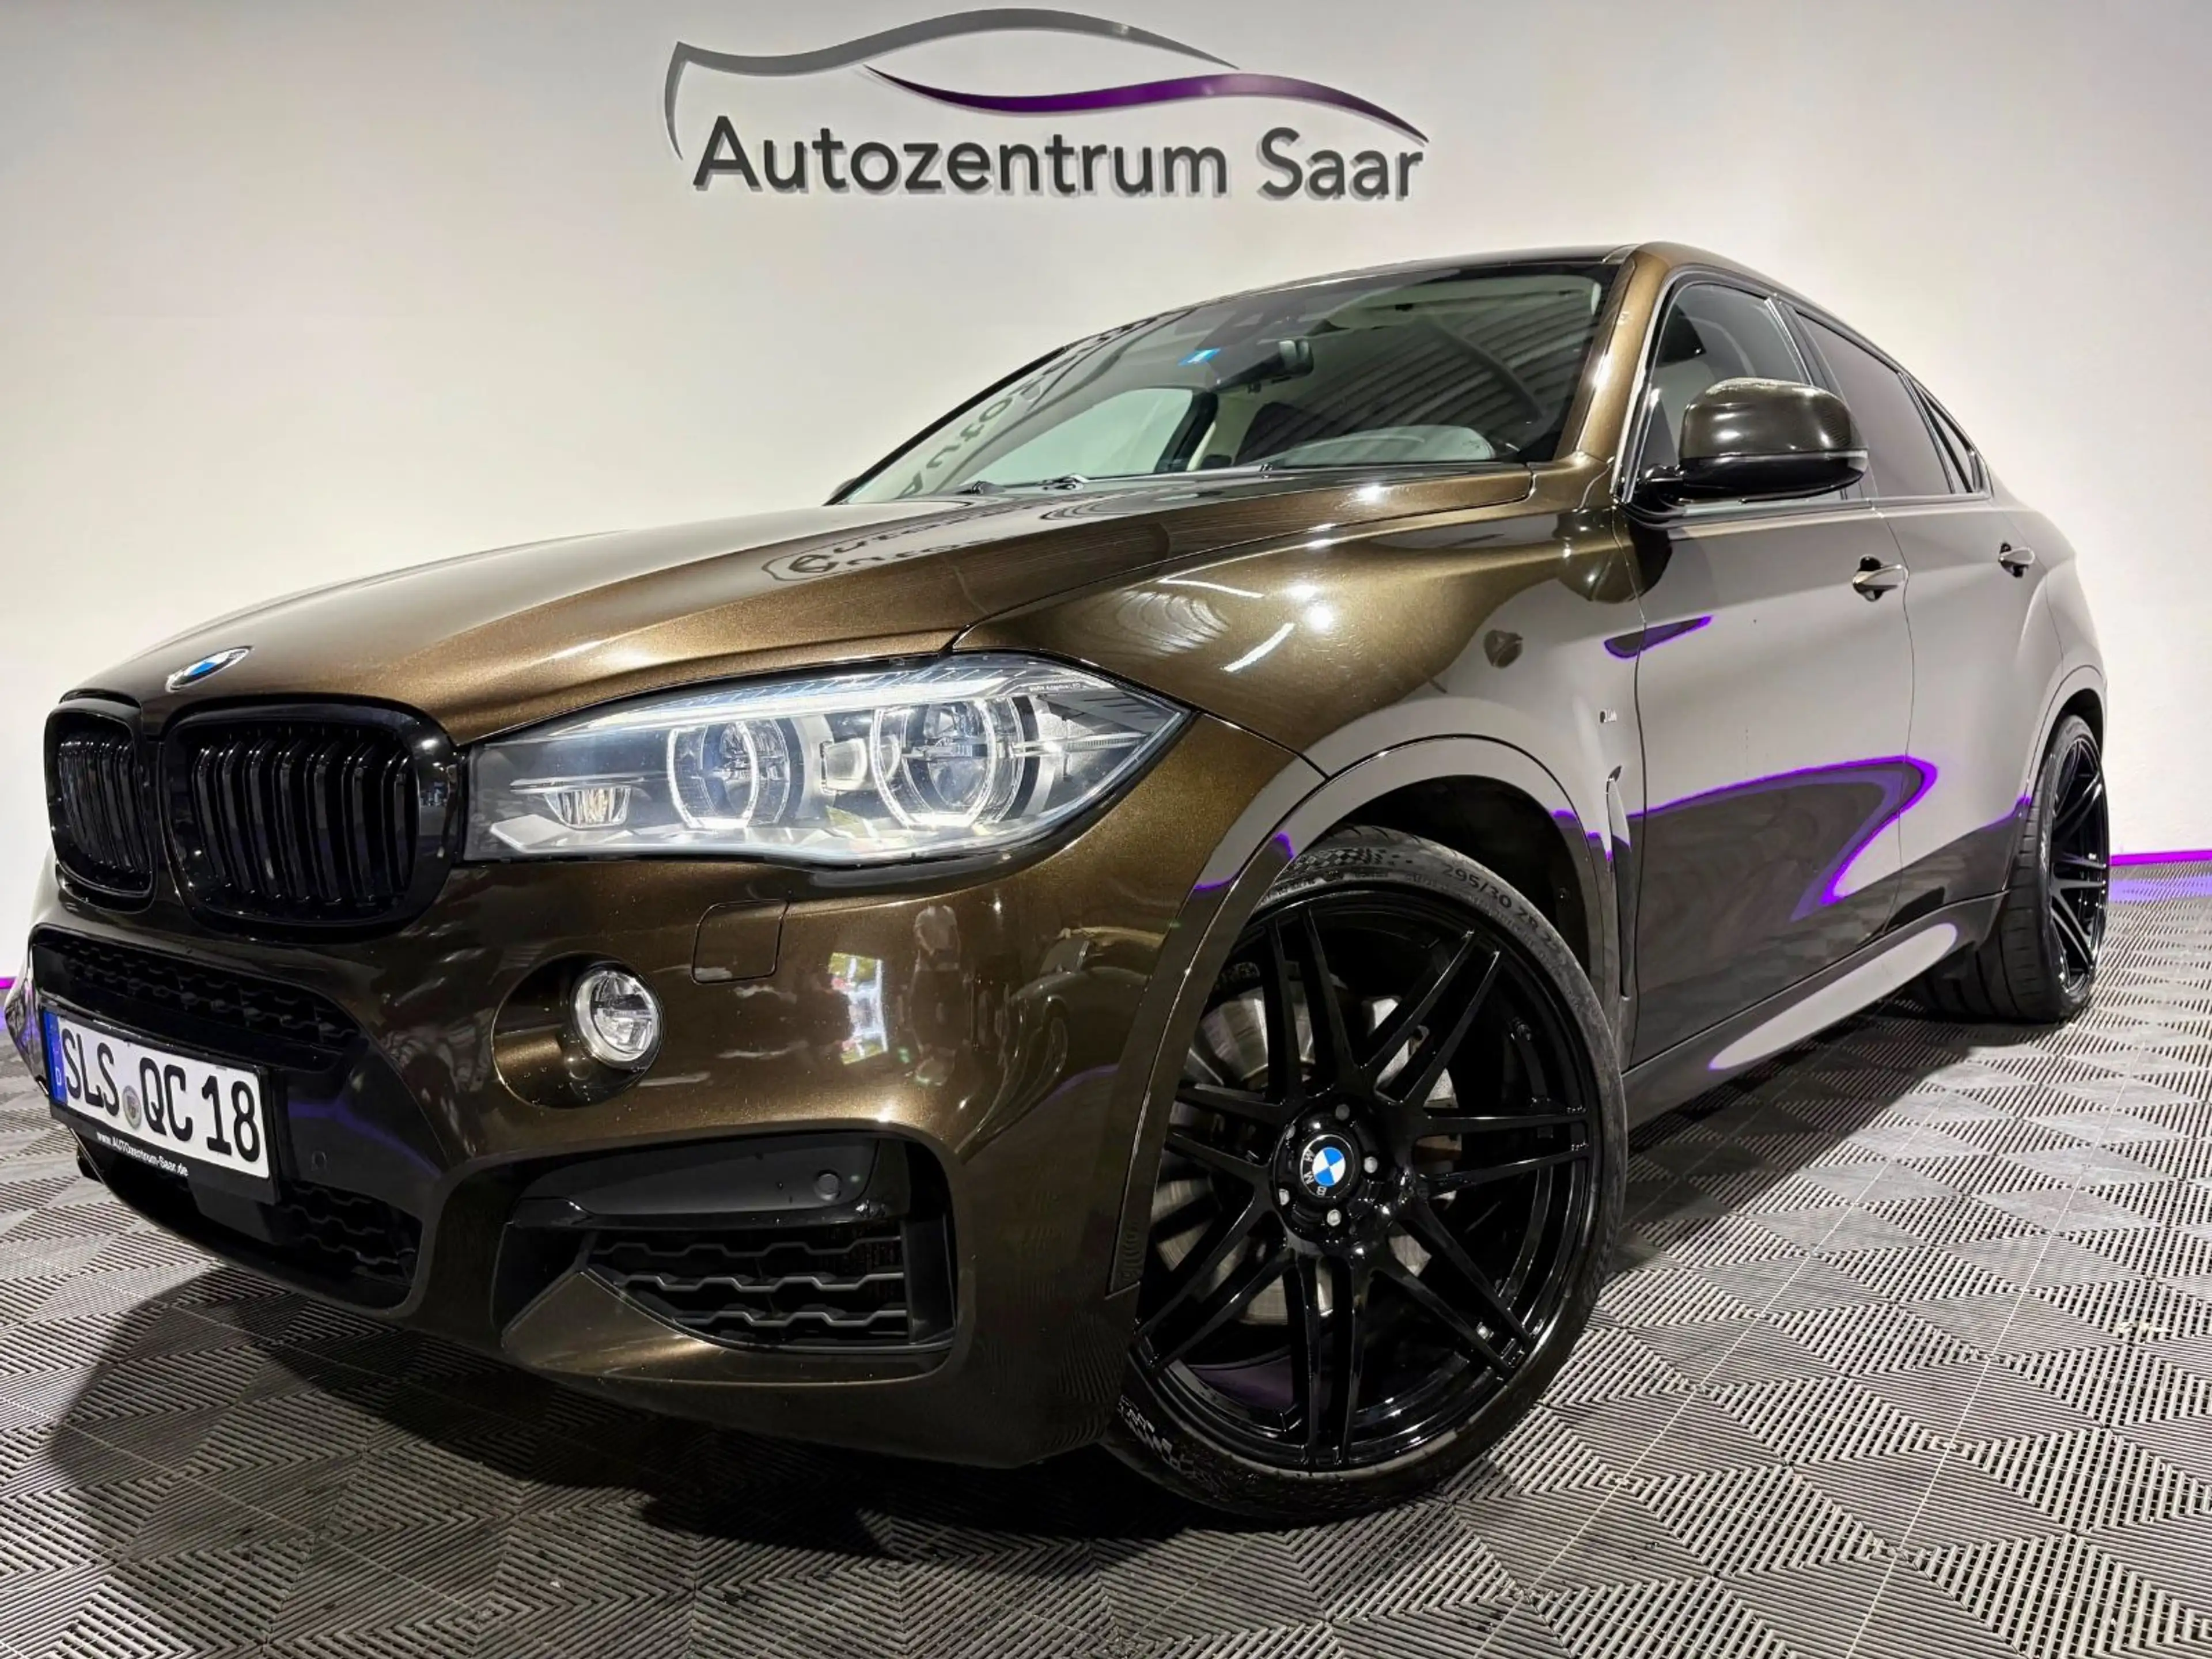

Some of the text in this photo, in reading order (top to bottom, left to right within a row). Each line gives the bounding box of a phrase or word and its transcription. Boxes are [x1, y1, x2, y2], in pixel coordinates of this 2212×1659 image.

[693, 116, 1423, 198] Autozentrum Saar
[1441, 864, 1512, 909] 295/30
[62, 1028, 260, 1162] SLS QC 18
